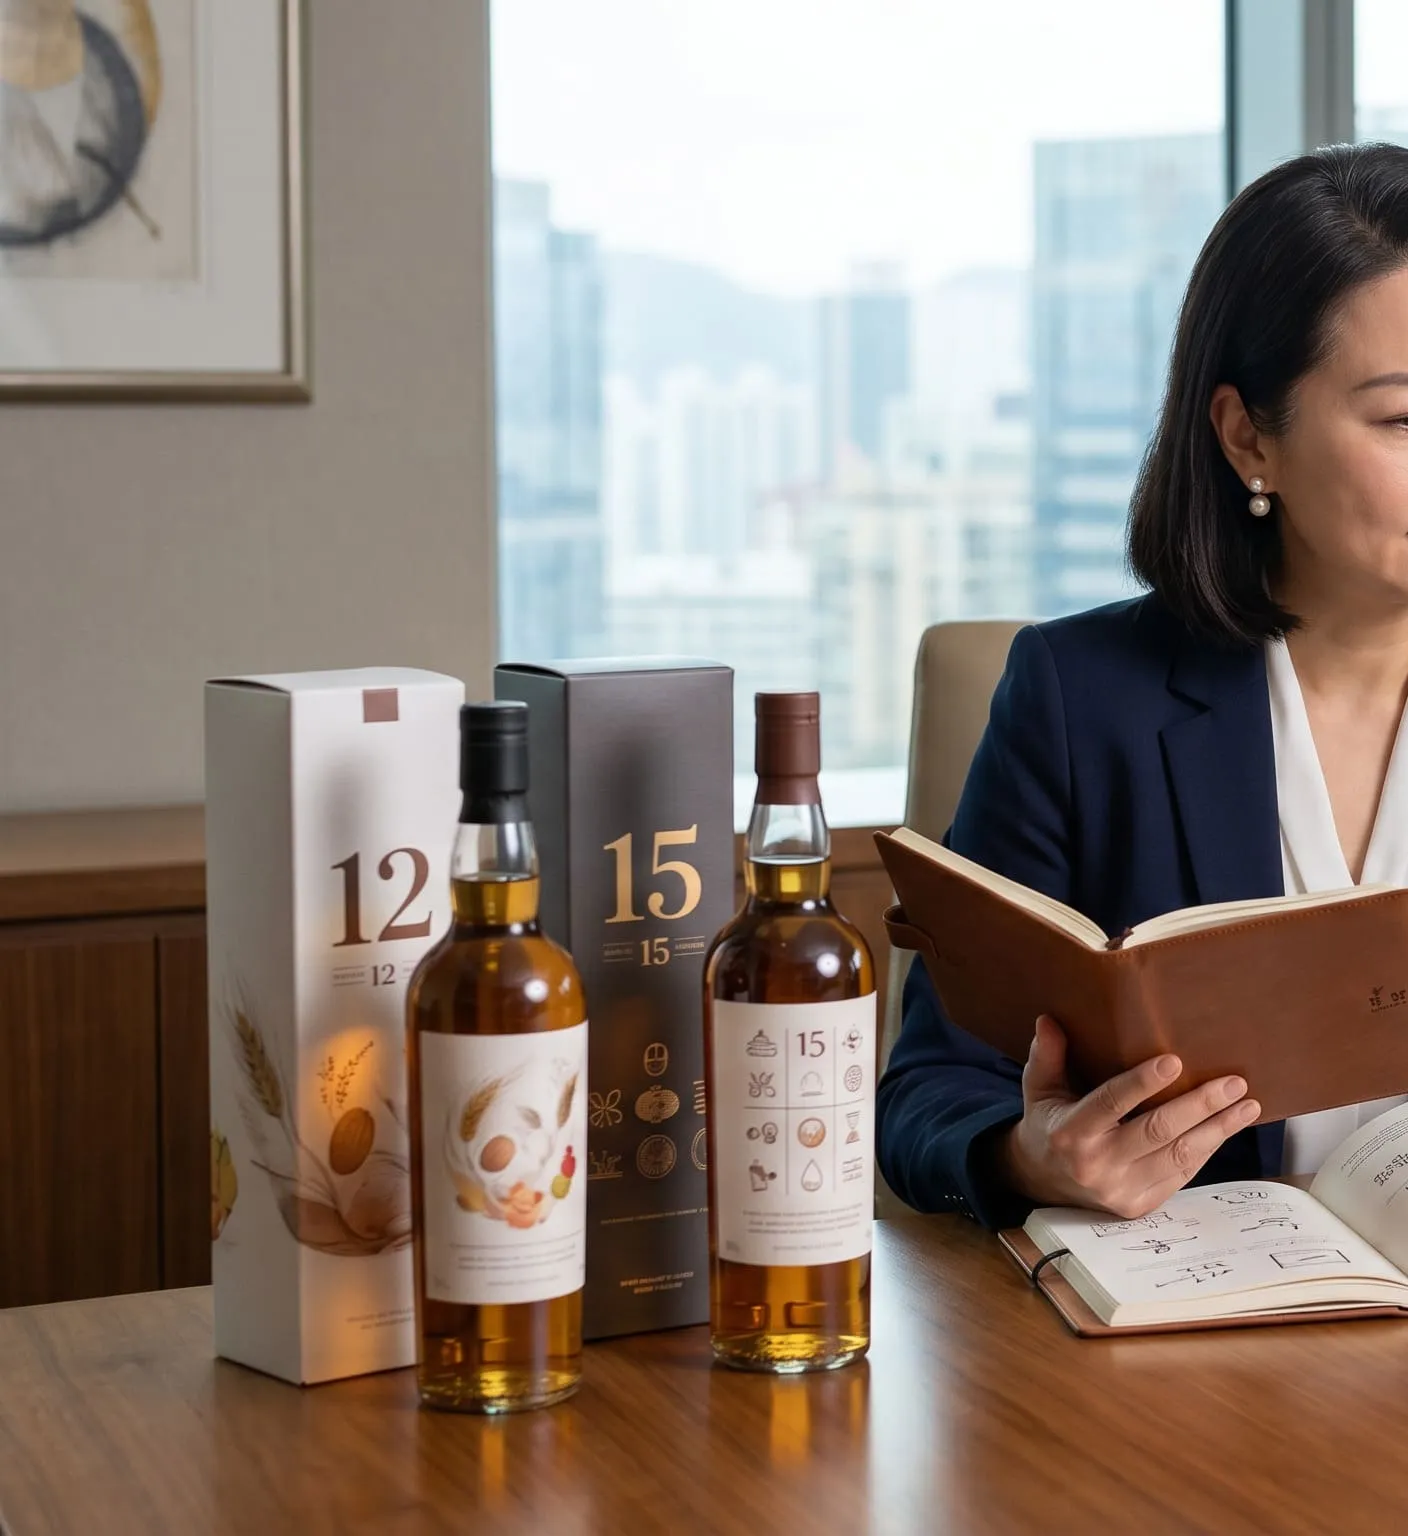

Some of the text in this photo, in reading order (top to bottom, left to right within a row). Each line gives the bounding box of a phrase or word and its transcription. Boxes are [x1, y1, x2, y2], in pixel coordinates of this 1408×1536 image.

[603, 823, 702, 924] 15
[331, 847, 433, 947] 12
[640, 937, 670, 966] 15
[372, 963, 396, 986] 12
[796, 1030, 826, 1058] 15
